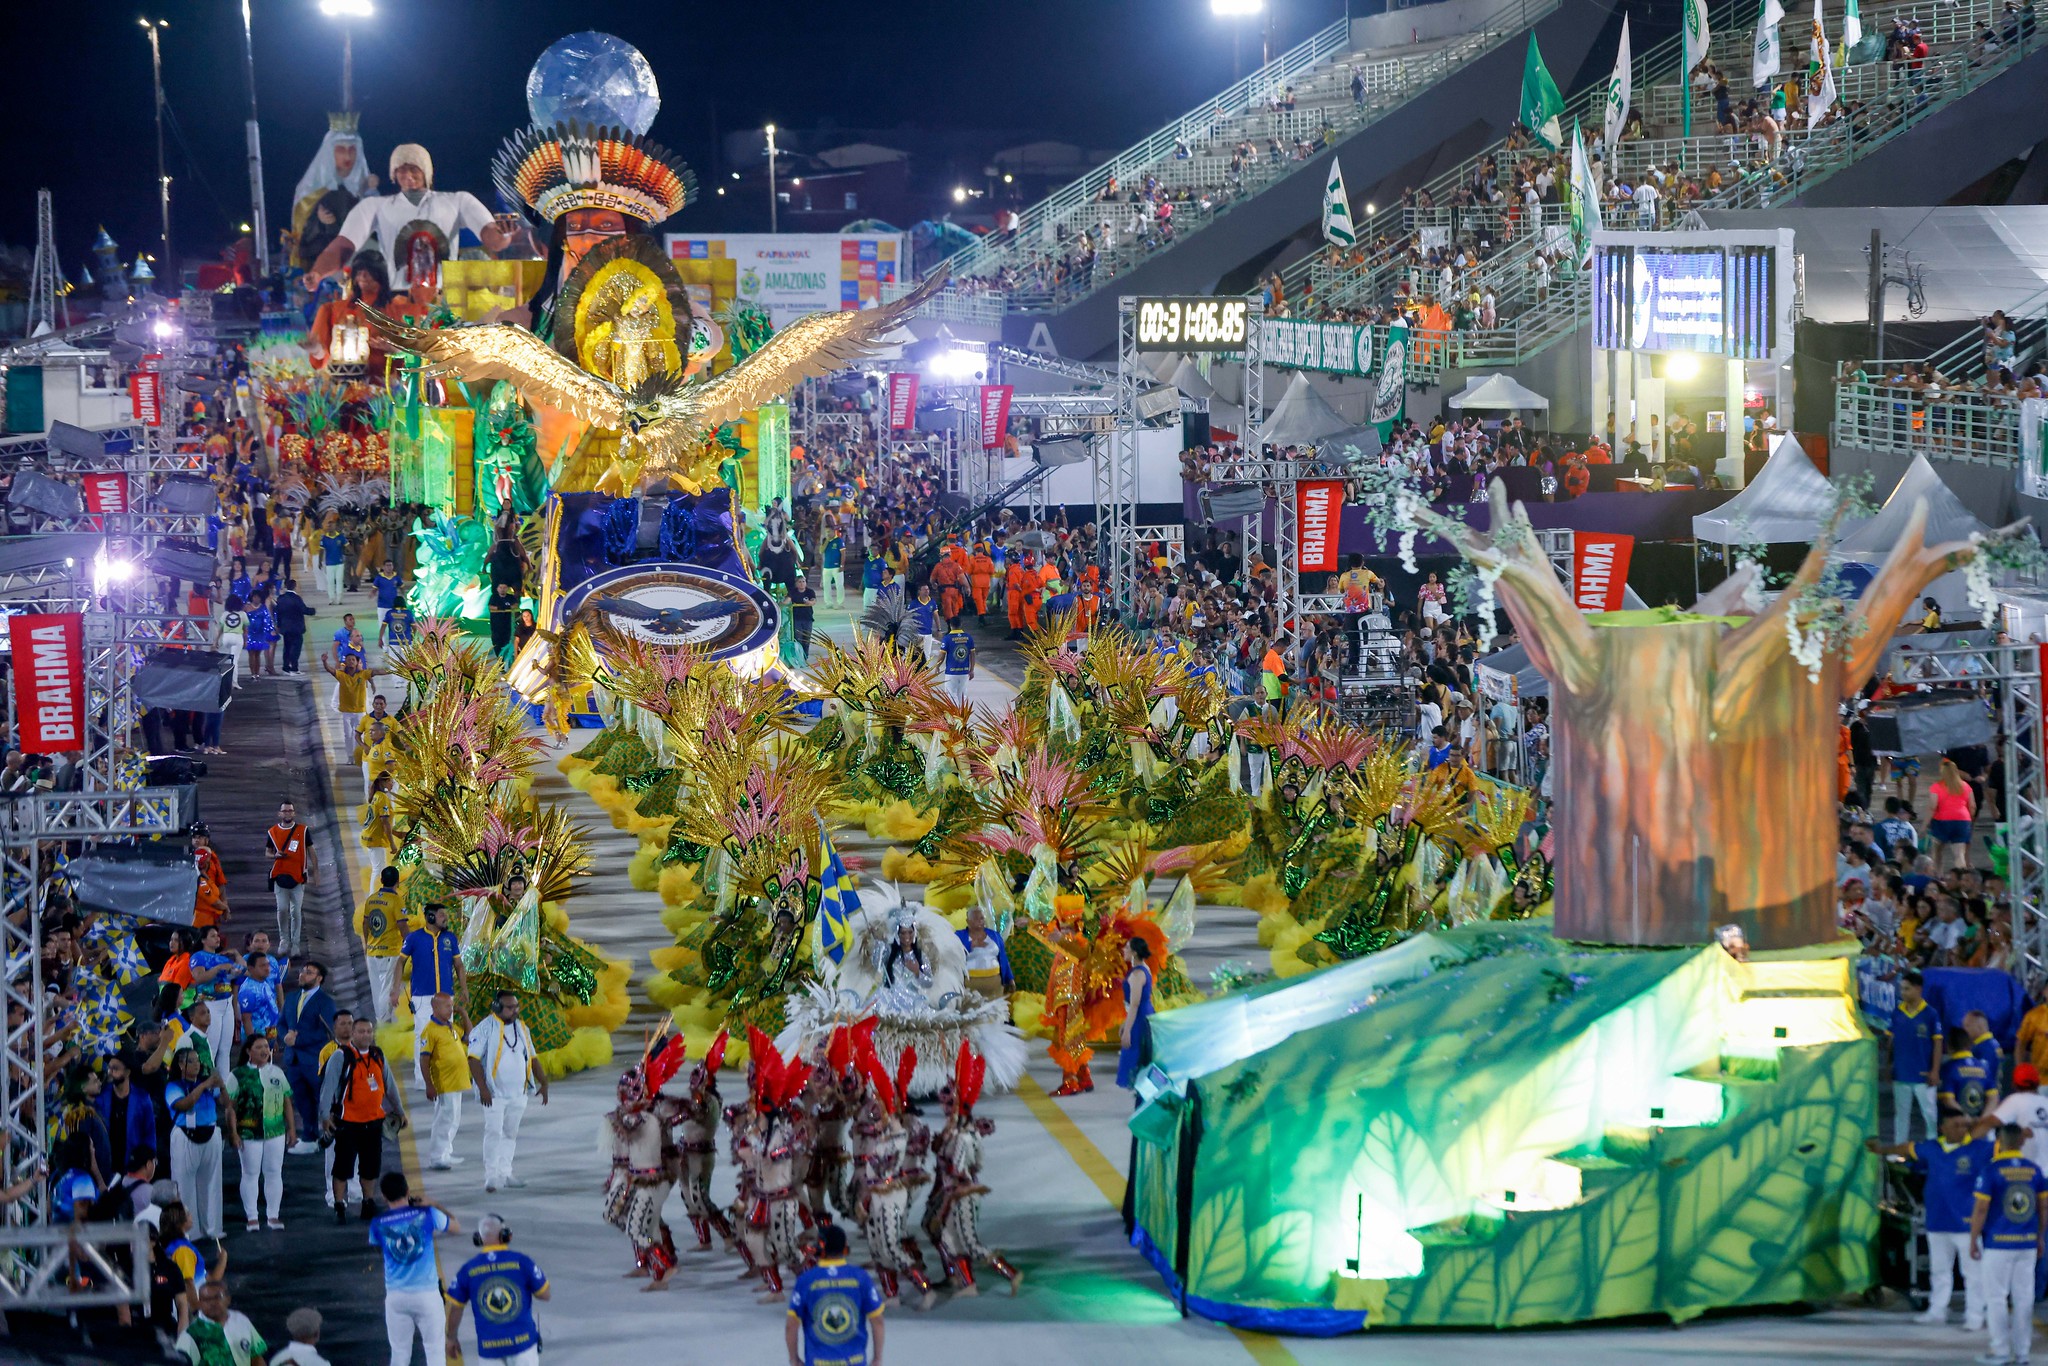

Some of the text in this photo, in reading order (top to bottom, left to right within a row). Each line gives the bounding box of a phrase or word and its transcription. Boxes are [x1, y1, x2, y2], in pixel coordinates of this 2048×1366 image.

[765, 272, 826, 289] AMAZONAS
[1028, 322, 1060, 357] A
[138, 376, 156, 422] BRAHMA
[893, 378, 911, 426] BRAHMA
[984, 389, 1004, 445] BRAHMA
[1302, 488, 1330, 565] BRAHMA
[642, 633, 703, 643] PRESIDENTE
[703, 618, 726, 637] VARGAS
[31, 625, 75, 741] BRAHMA
